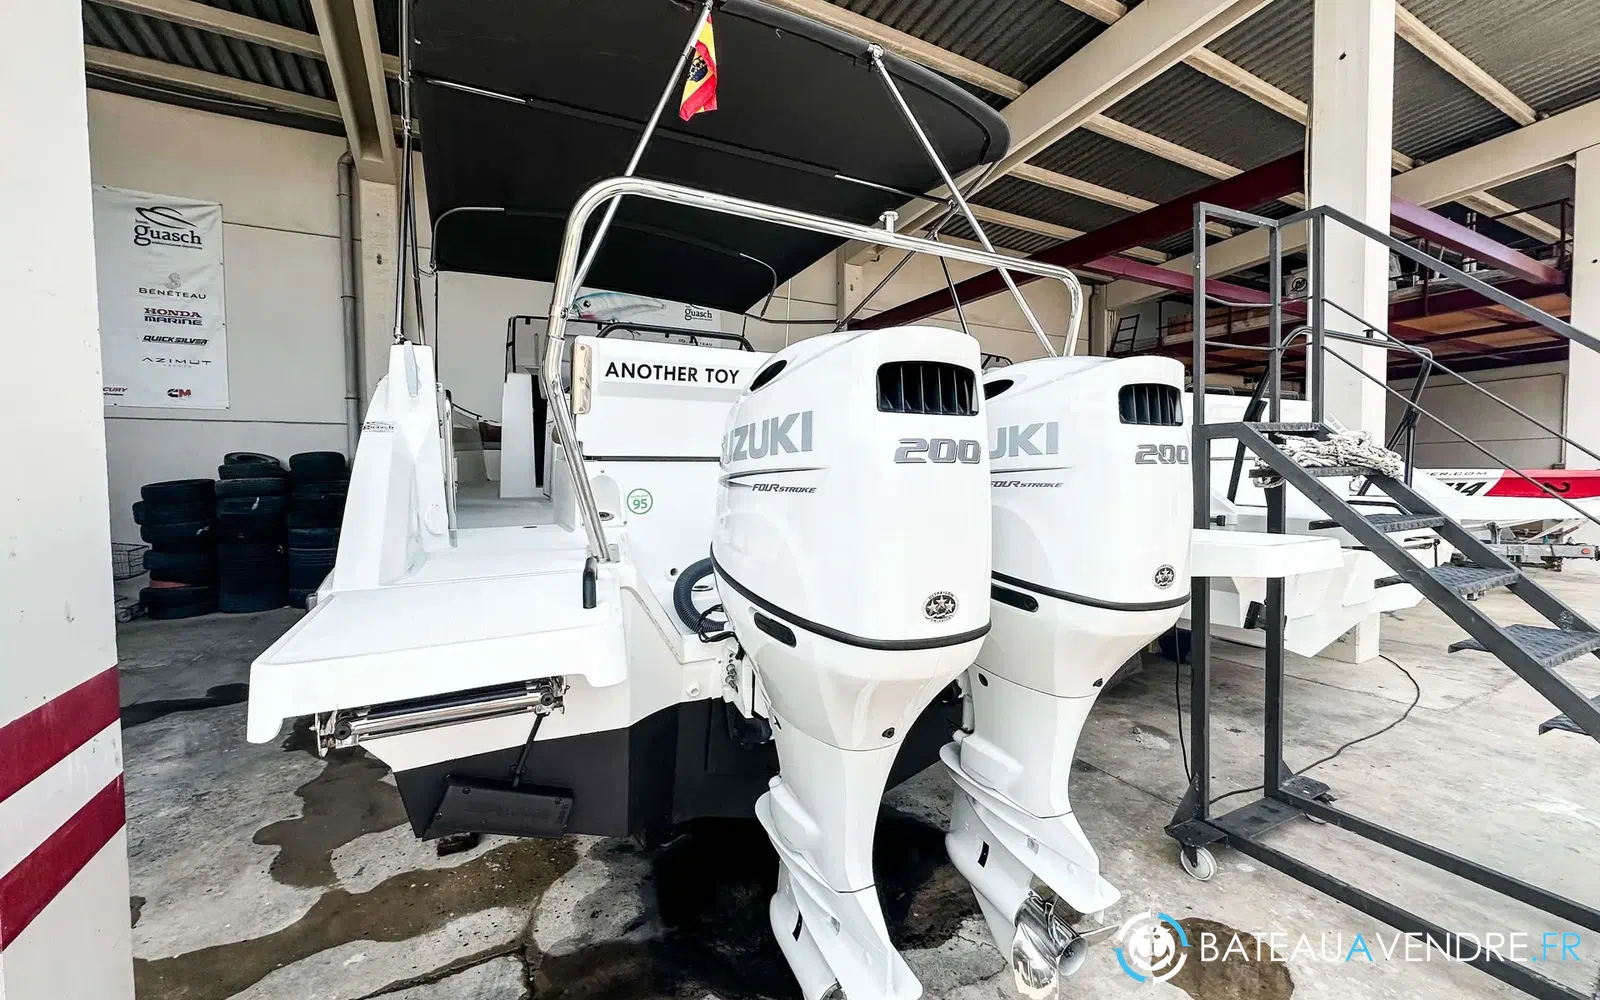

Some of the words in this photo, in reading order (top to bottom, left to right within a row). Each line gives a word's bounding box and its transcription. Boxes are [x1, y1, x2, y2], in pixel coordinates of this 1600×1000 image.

[134, 225, 202, 246] guasch
[144, 308, 202, 318] HONDA
[684, 308, 713, 321] guasch
[144, 316, 203, 326] MARINE
[142, 335, 208, 346] QUICKSILVER
[142, 357, 212, 365] AZIMUT
[604, 361, 698, 382] ANOTHER
[705, 368, 740, 384] TOY
[893, 438, 982, 464] 200
[1134, 443, 1190, 465] 200
[632, 498, 648, 510] 95
